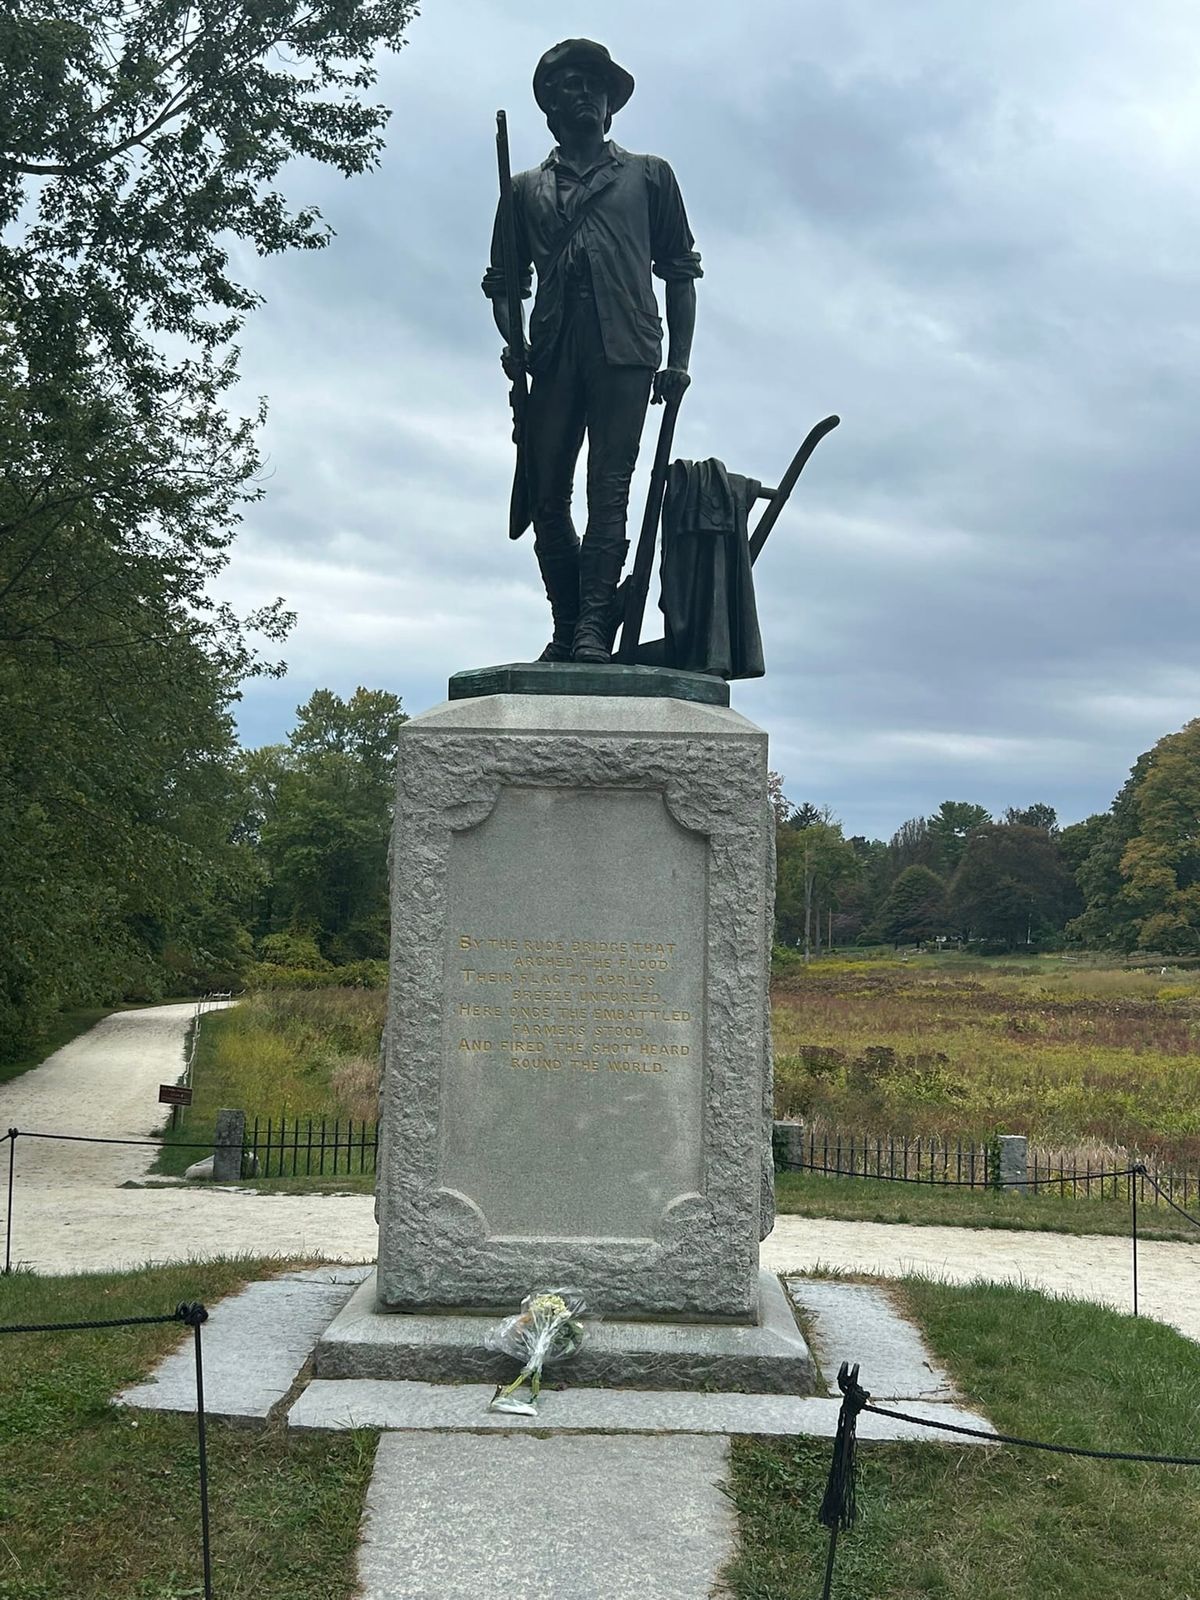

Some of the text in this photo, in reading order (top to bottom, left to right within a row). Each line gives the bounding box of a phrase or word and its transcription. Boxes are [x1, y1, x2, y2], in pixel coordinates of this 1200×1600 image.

[489, 940, 517, 949] THE
[525, 940, 564, 951] RUDE
[572, 942, 626, 953] BRIDGE
[633, 944, 676, 954] THAT
[514, 956, 574, 968] ARCHED
[581, 958, 611, 968] THE
[520, 974, 560, 985] FLAG
[569, 975, 586, 985] TO
[513, 990, 571, 1002] BREEZE
[511, 1007, 550, 1018] ONCE
[558, 1008, 587, 1019] THE
[594, 1009, 691, 1022] EMBATTLED
[512, 1024, 585, 1035] FARMERS
[501, 1041, 544, 1052] FIRED
[553, 1042, 582, 1053] THE
[592, 1043, 632, 1054] SHOT
[640, 1044, 689, 1055] HEARD
[512, 1058, 668, 1073] ROUND THE WORLD.
